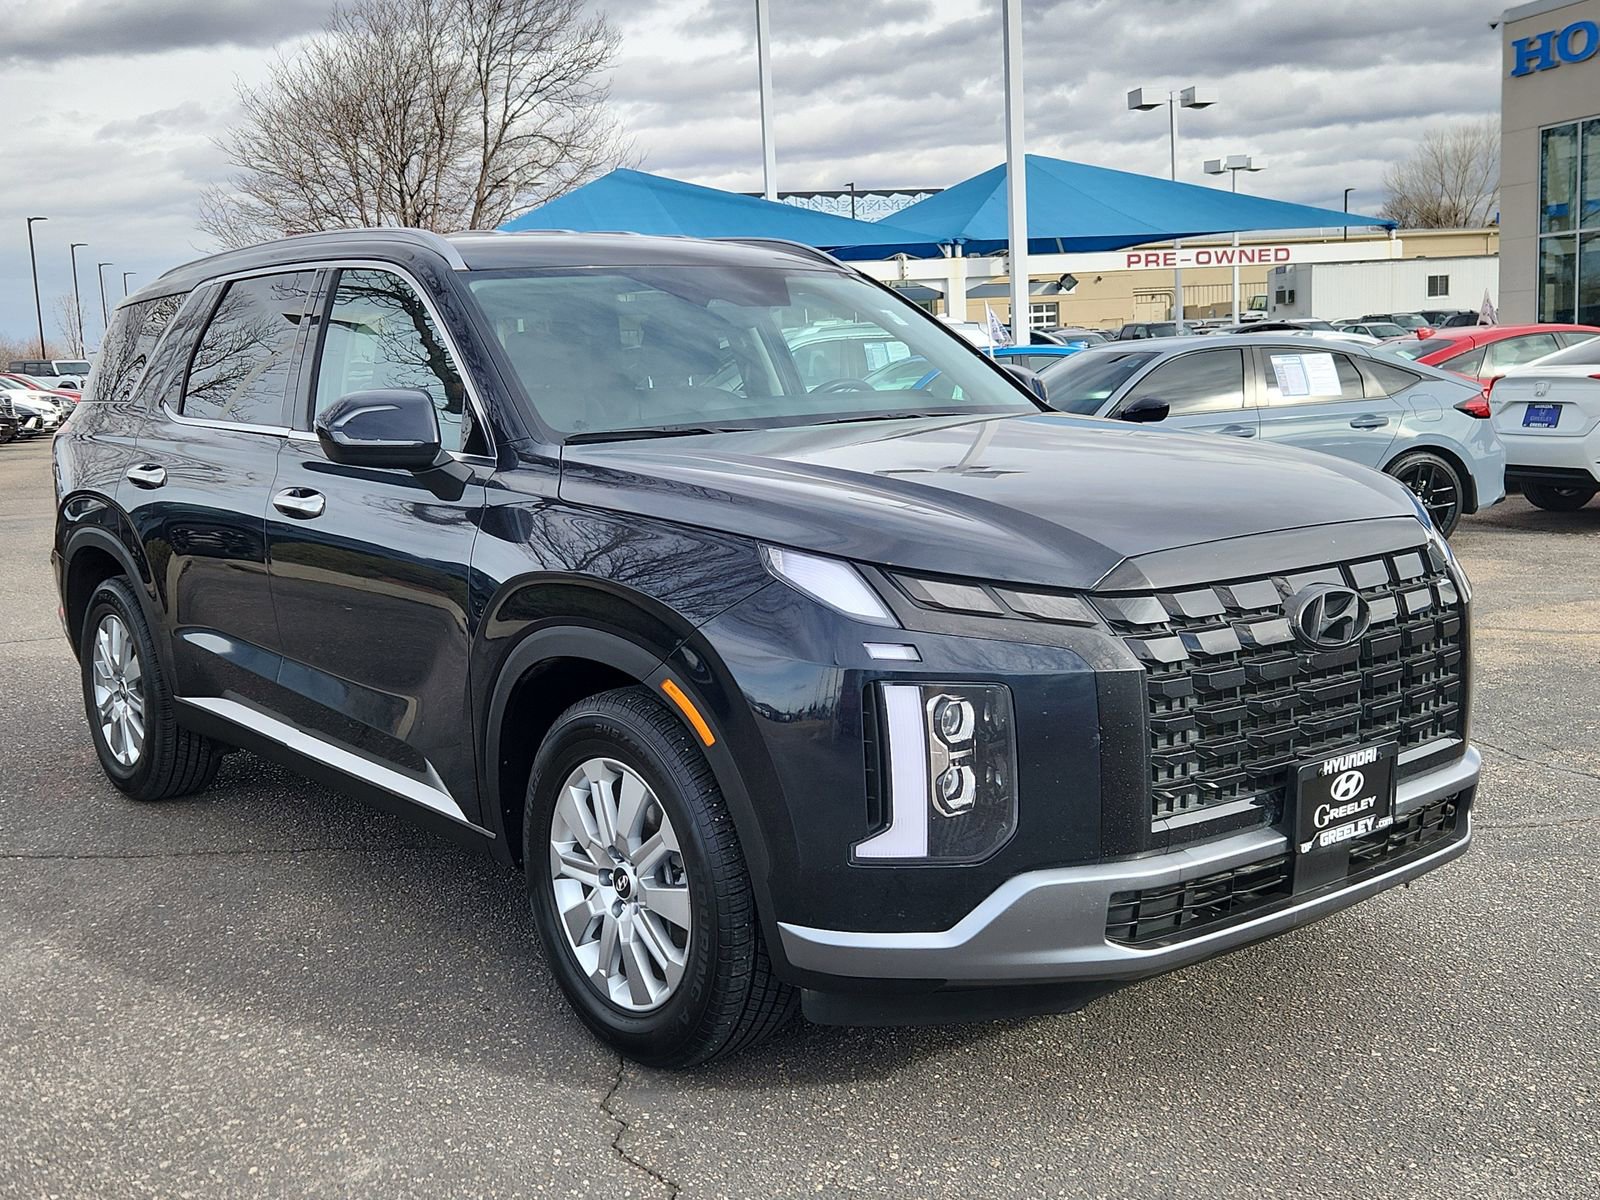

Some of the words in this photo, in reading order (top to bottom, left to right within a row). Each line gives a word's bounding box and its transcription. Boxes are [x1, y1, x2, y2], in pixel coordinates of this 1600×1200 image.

[1511, 20, 1600, 76] HO
[1126, 247, 1291, 268] PRE-OWNED
[1323, 747, 1377, 775] HYUNDAI
[1313, 795, 1377, 828] GREELEY
